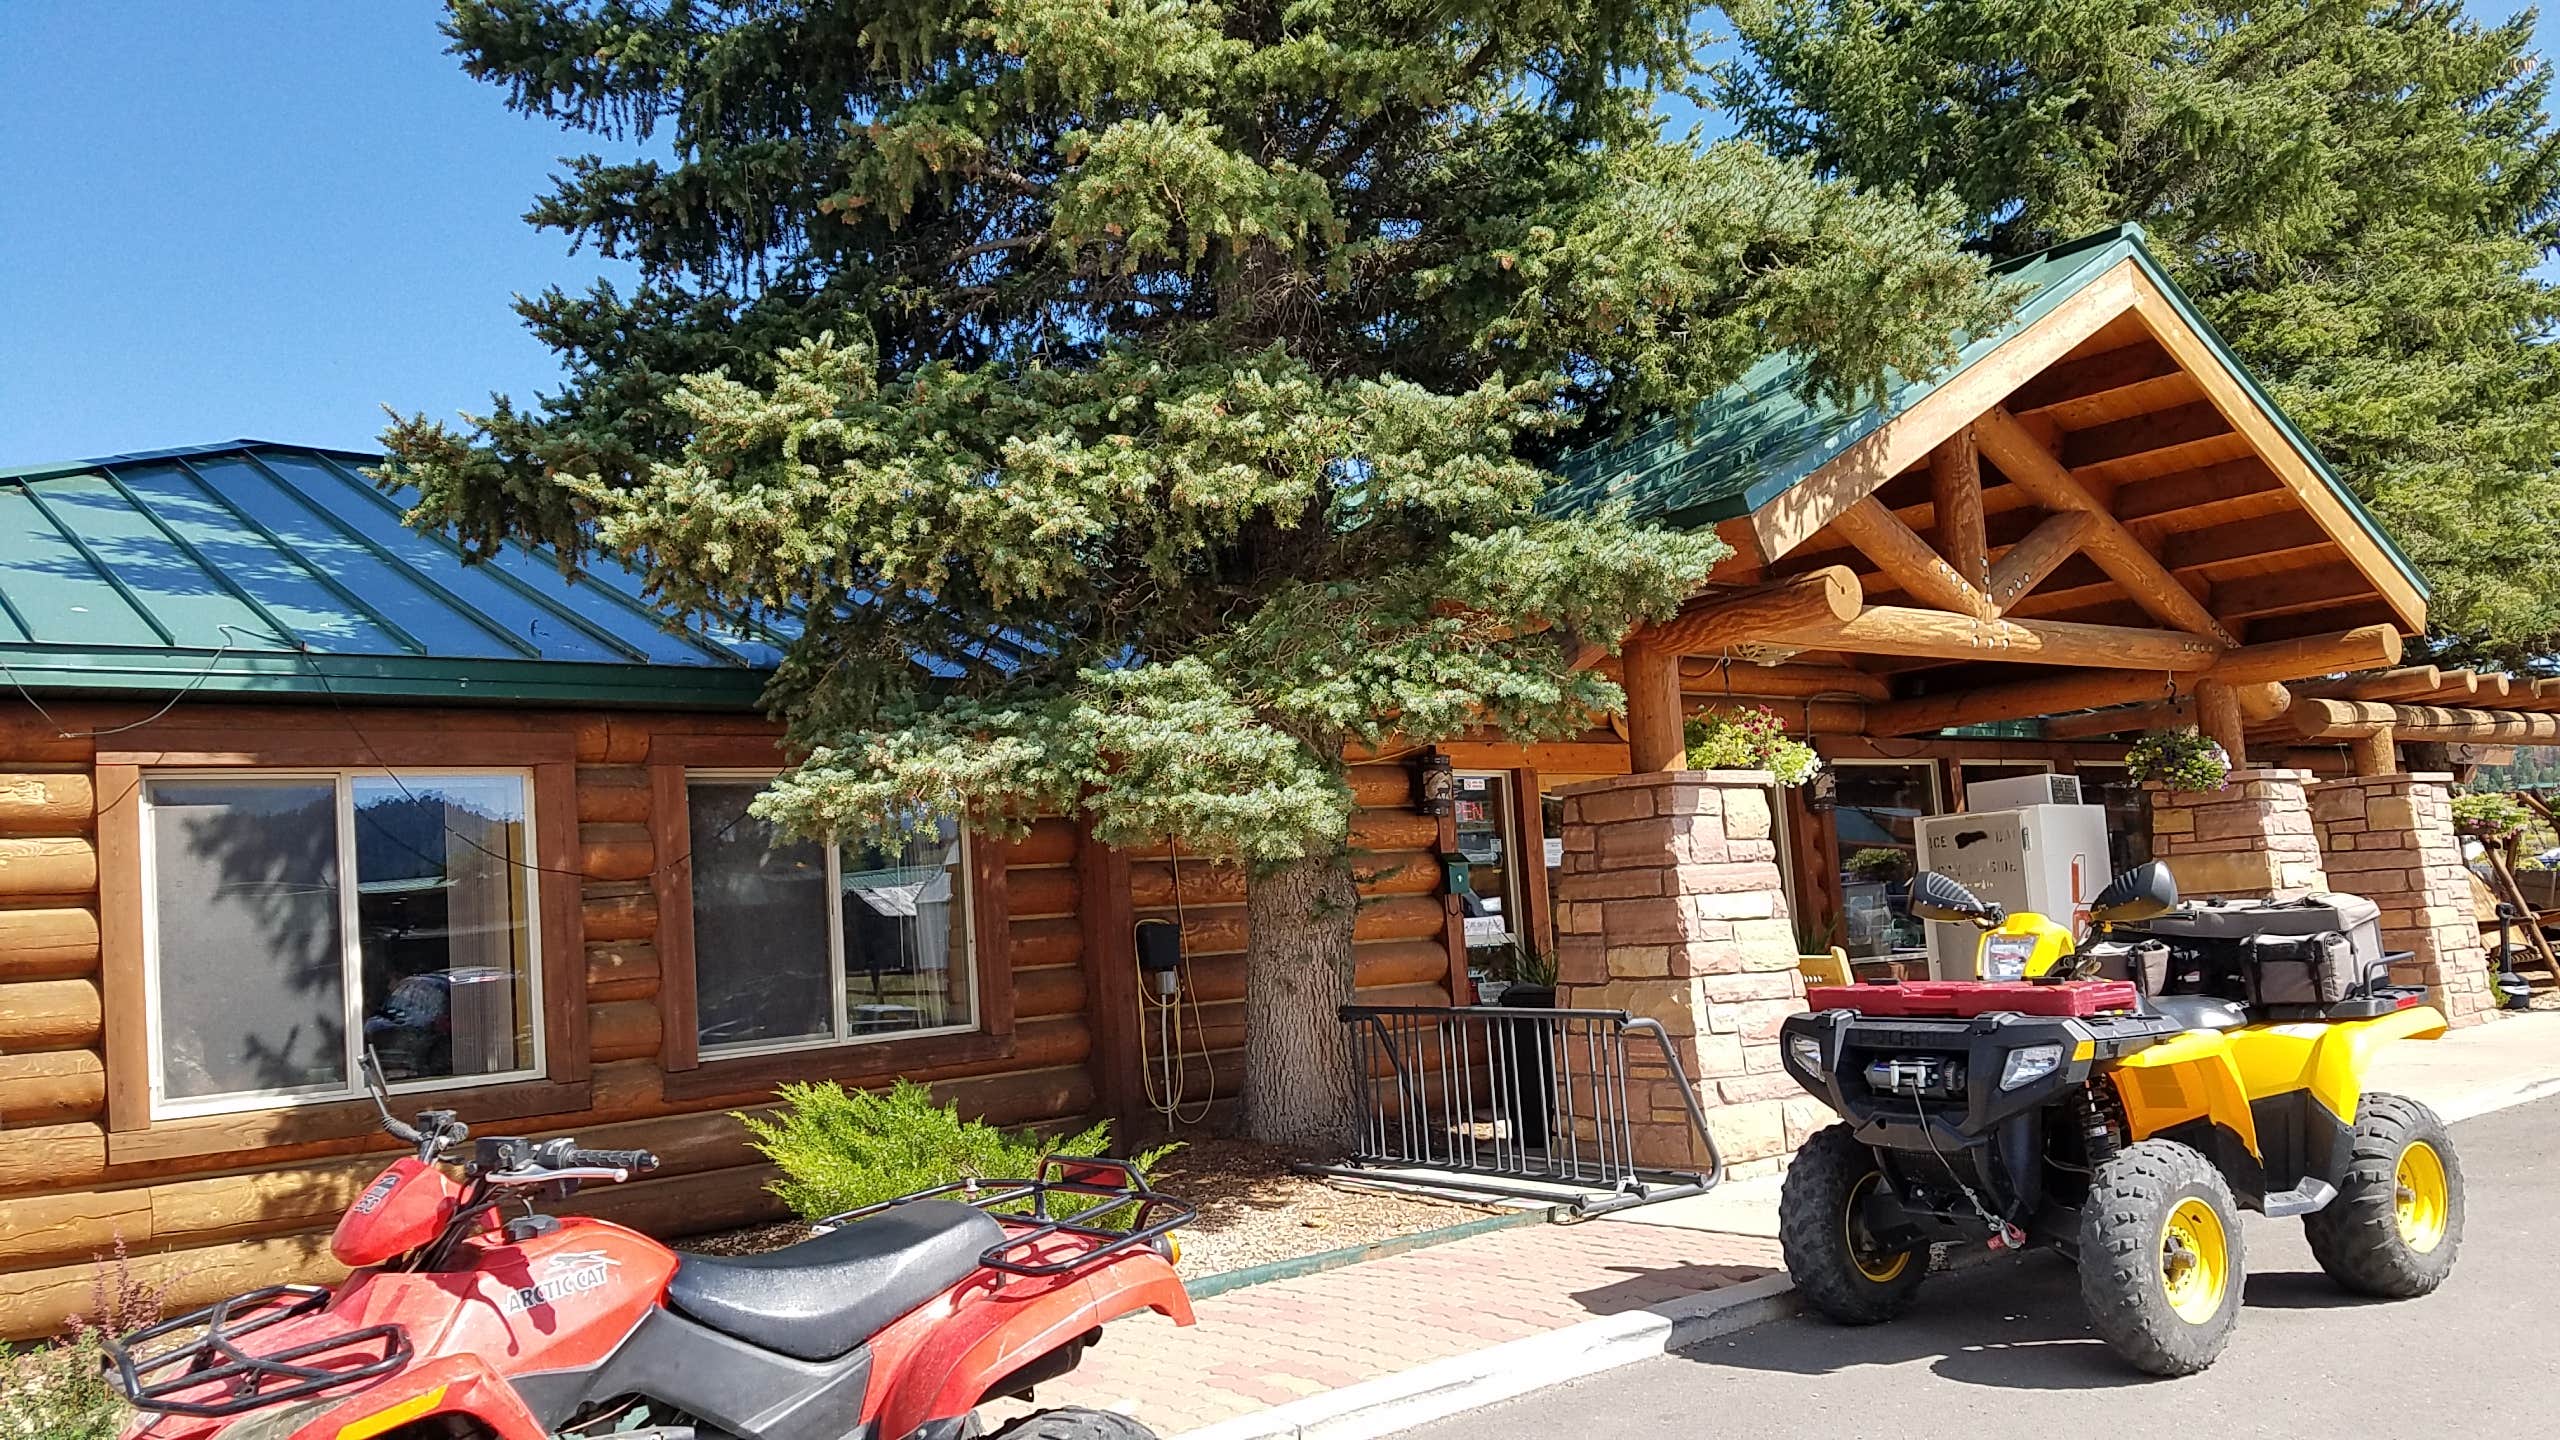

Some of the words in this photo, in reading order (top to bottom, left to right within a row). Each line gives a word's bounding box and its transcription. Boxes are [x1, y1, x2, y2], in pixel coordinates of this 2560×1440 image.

[1929, 835, 1947, 849] ICE
[508, 1275, 573, 1313] ARCTIC
[576, 1265, 607, 1289] CAT
